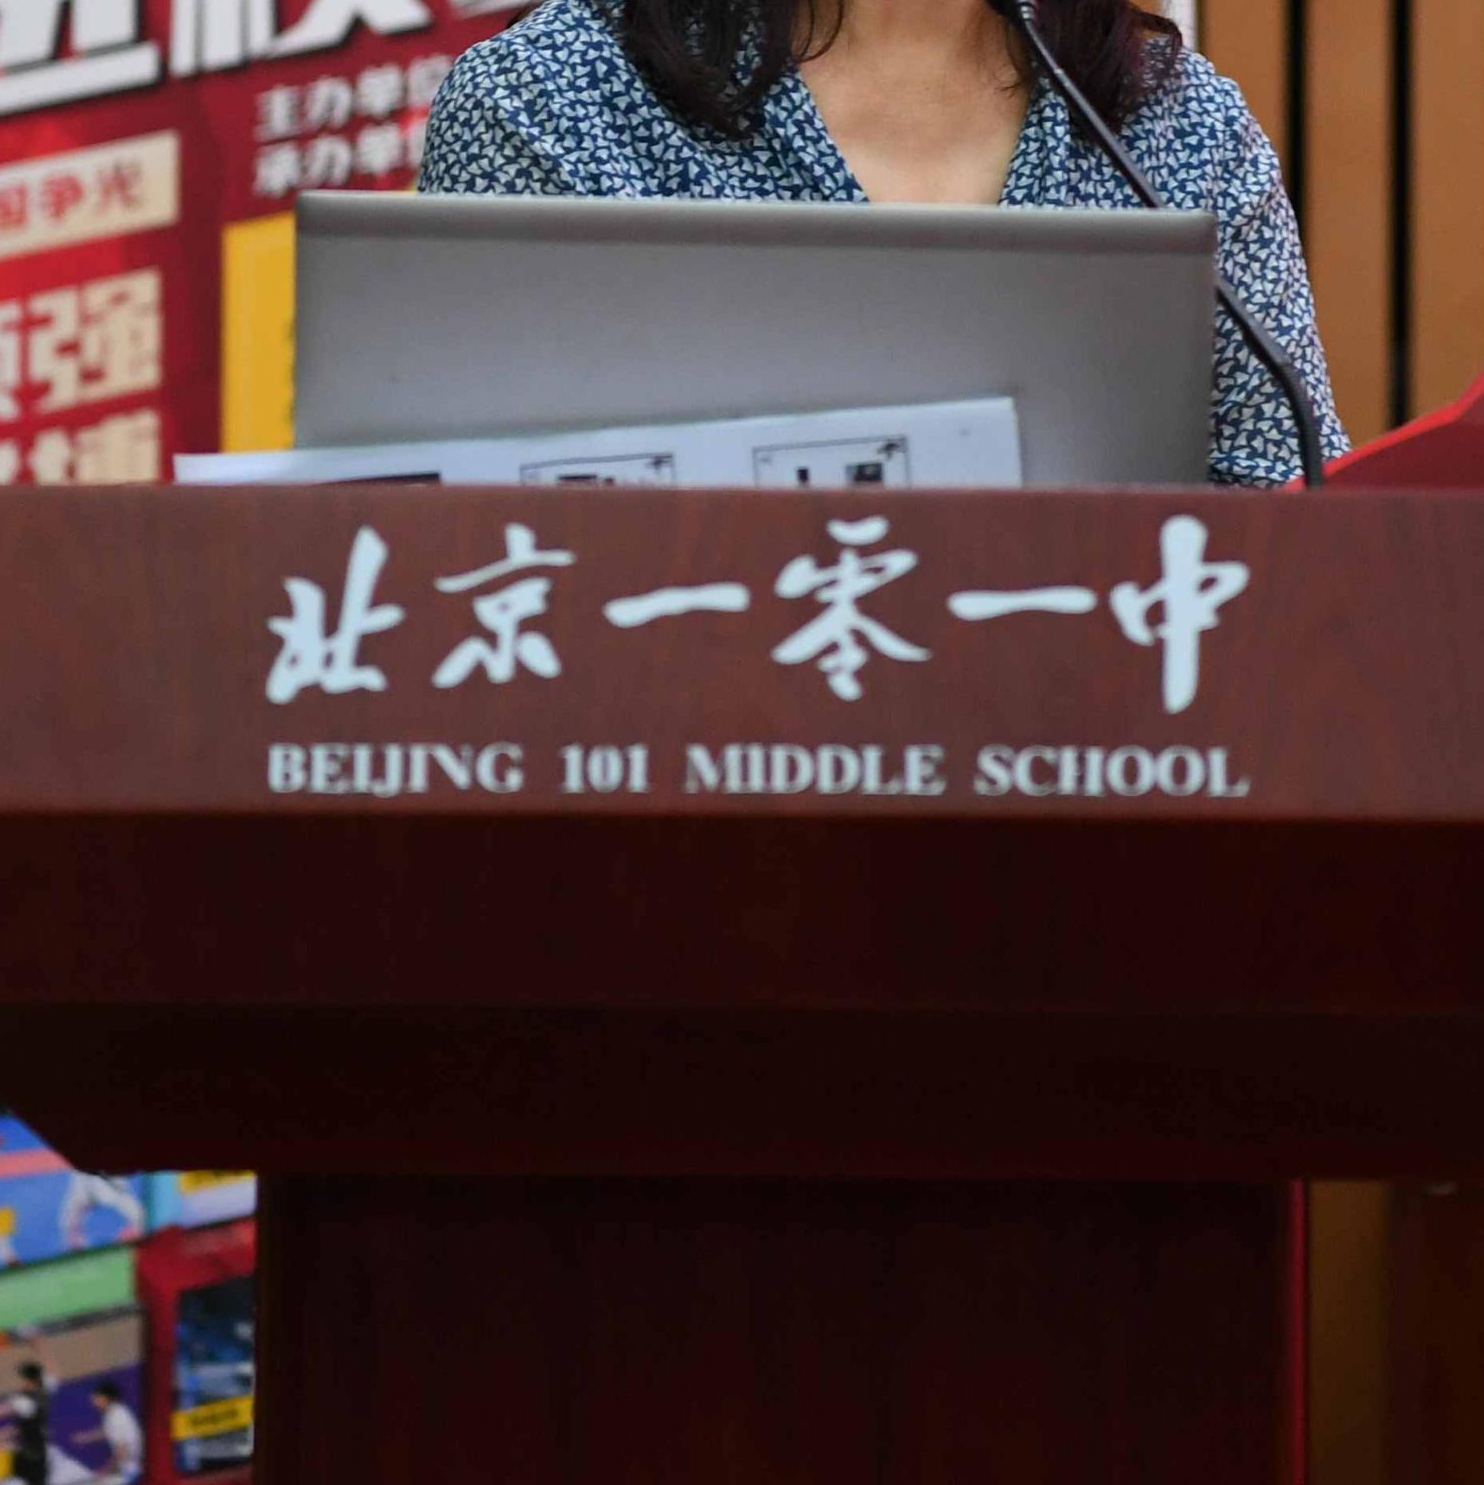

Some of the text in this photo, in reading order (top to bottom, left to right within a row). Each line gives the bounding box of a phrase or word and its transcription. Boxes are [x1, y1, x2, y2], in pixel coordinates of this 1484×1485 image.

[265, 515, 1251, 714] 北京一零一中
[267, 741, 1252, 799] BEIJING 101 MIDDLE SCHOOL
